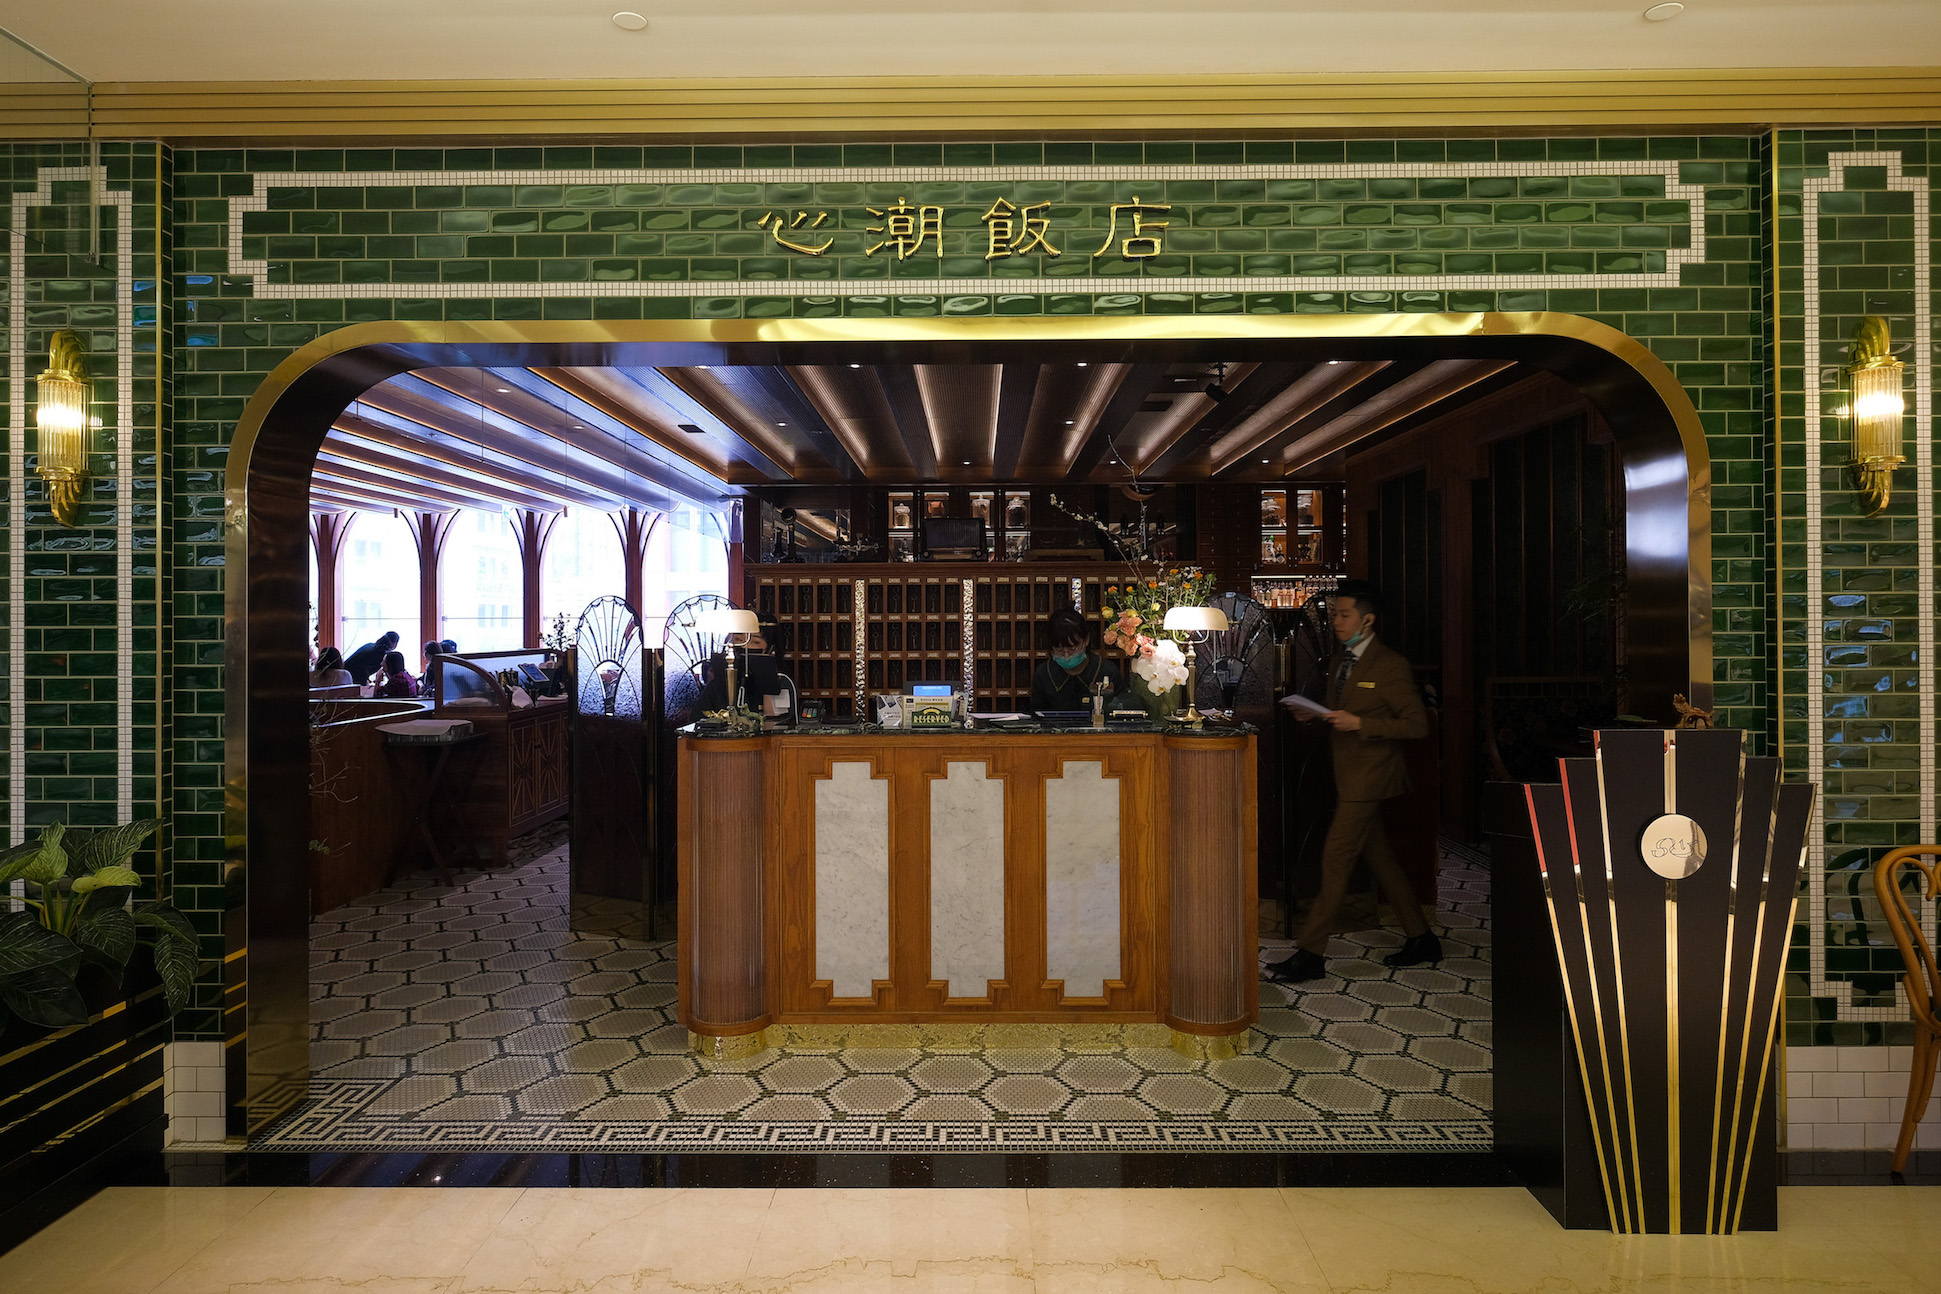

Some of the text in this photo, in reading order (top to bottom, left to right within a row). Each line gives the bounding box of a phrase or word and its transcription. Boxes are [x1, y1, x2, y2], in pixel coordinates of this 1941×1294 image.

[757, 195, 1172, 260] 心潮飯店
[913, 715, 950, 724] RESERVED
